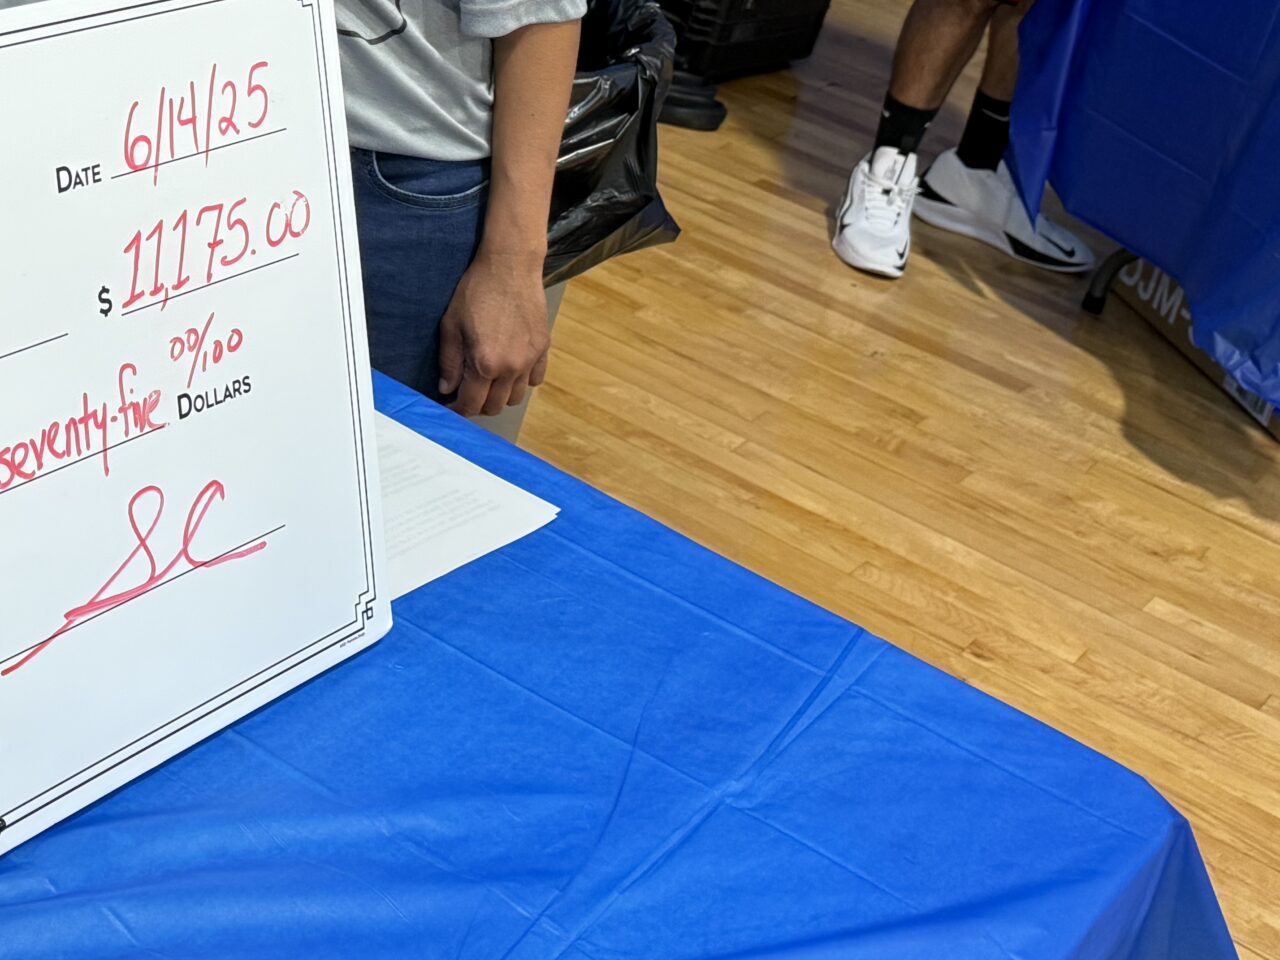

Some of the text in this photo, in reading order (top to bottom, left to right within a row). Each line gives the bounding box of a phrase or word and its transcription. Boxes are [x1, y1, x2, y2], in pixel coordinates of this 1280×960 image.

[123, 61, 269, 187] 6/14/25
[55, 164, 103, 194] DATE
[121, 190, 311, 312] 11,175.00
[97, 285, 113, 318] $
[177, 375, 252, 420] DOLLARS
